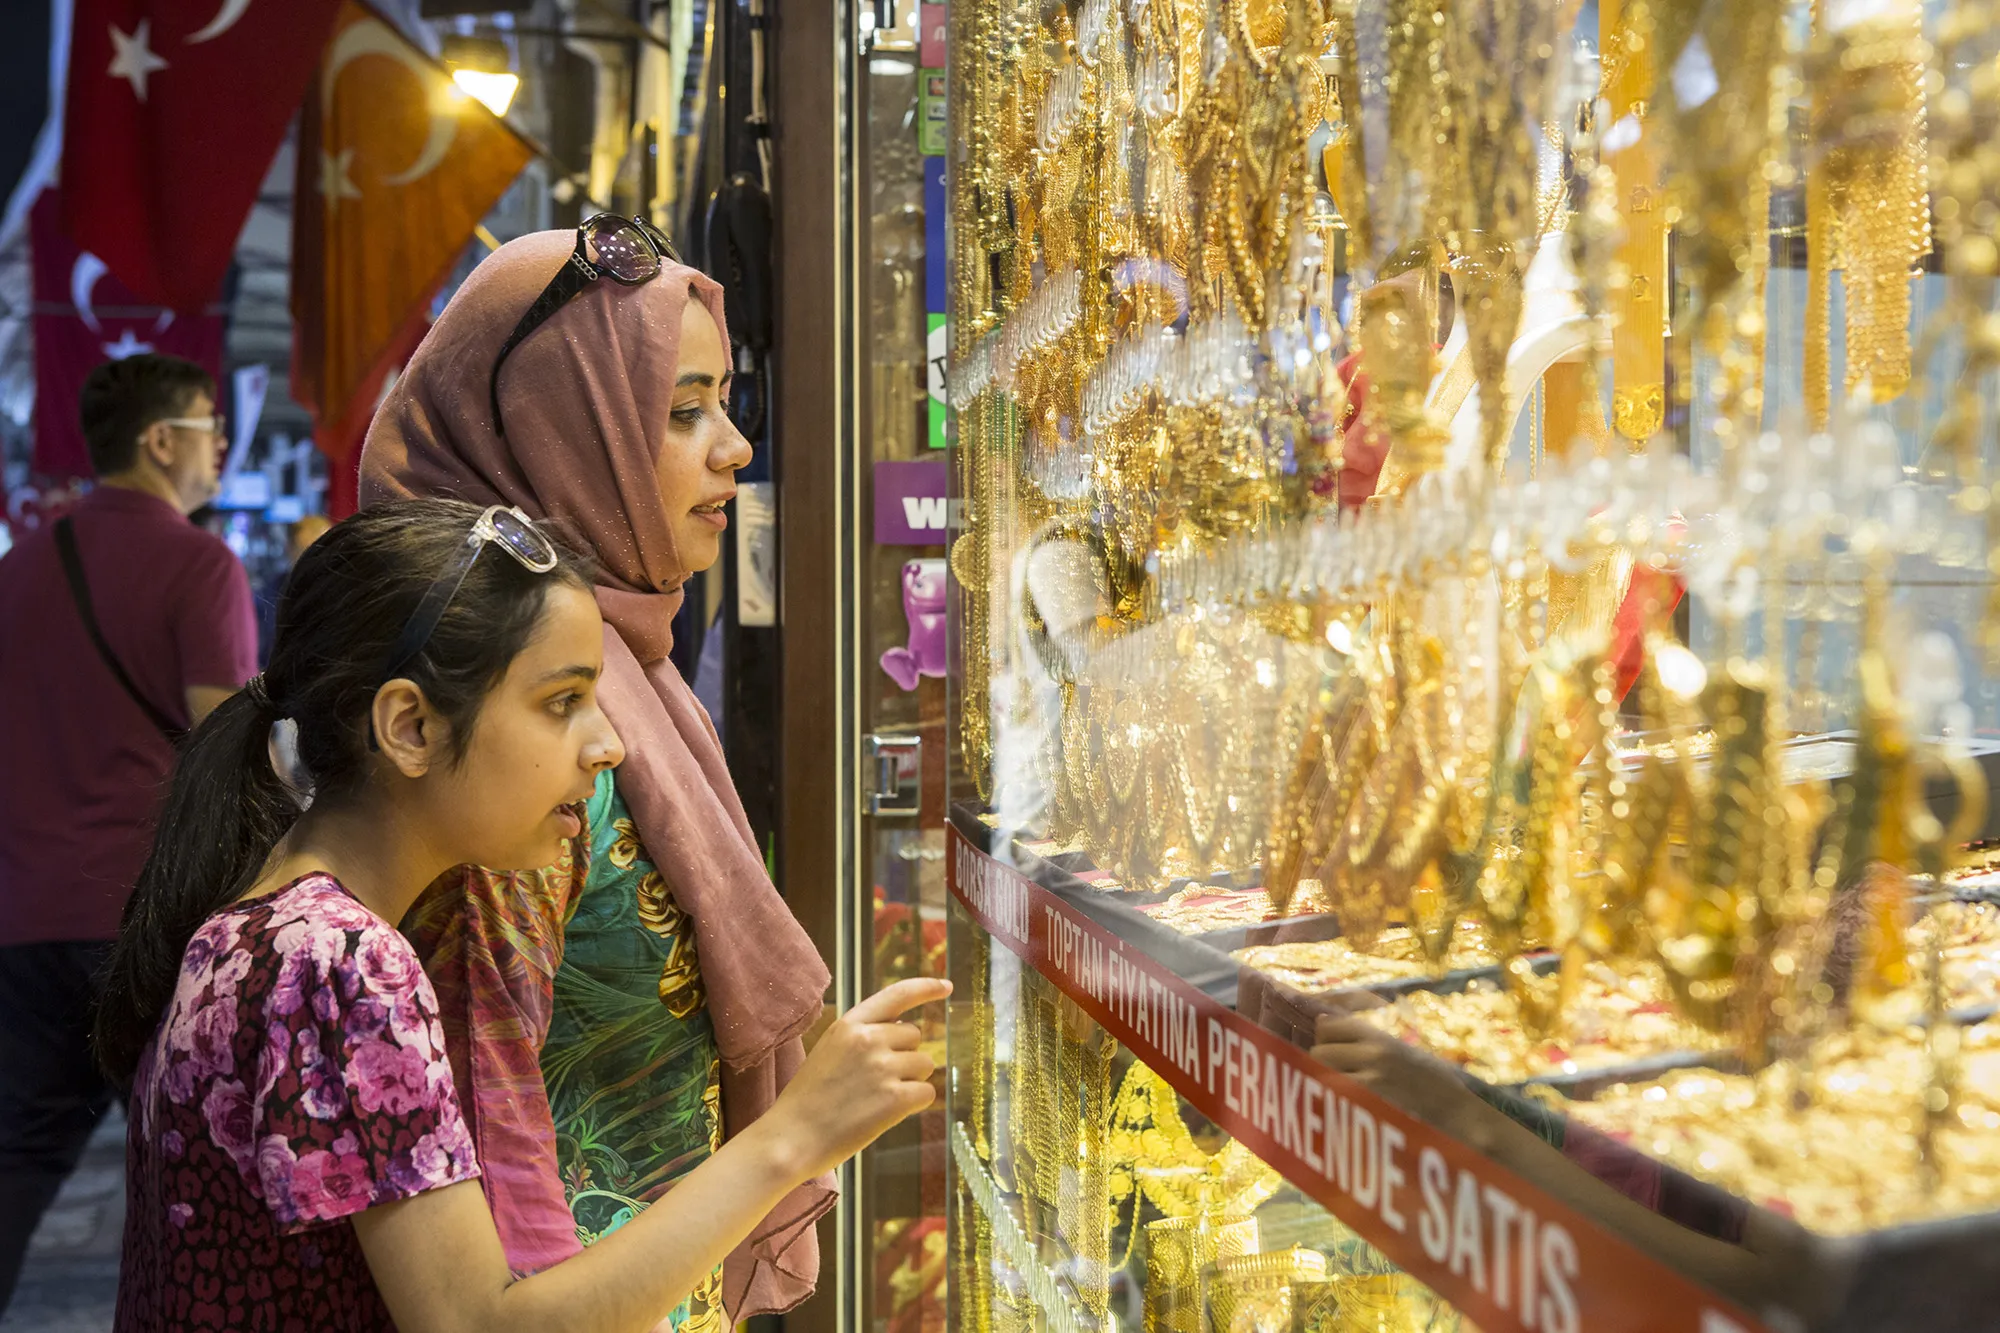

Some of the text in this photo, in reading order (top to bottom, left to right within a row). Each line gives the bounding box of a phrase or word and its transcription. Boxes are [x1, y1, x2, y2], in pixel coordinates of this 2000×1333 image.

[955, 836, 992, 919] BORSA
[995, 867, 1029, 945] GOLD
[1045, 904, 1103, 1004] TOPTAN
[1108, 940, 1201, 1084] FİYATINA
[1207, 1017, 1406, 1234] PERAKENDE
